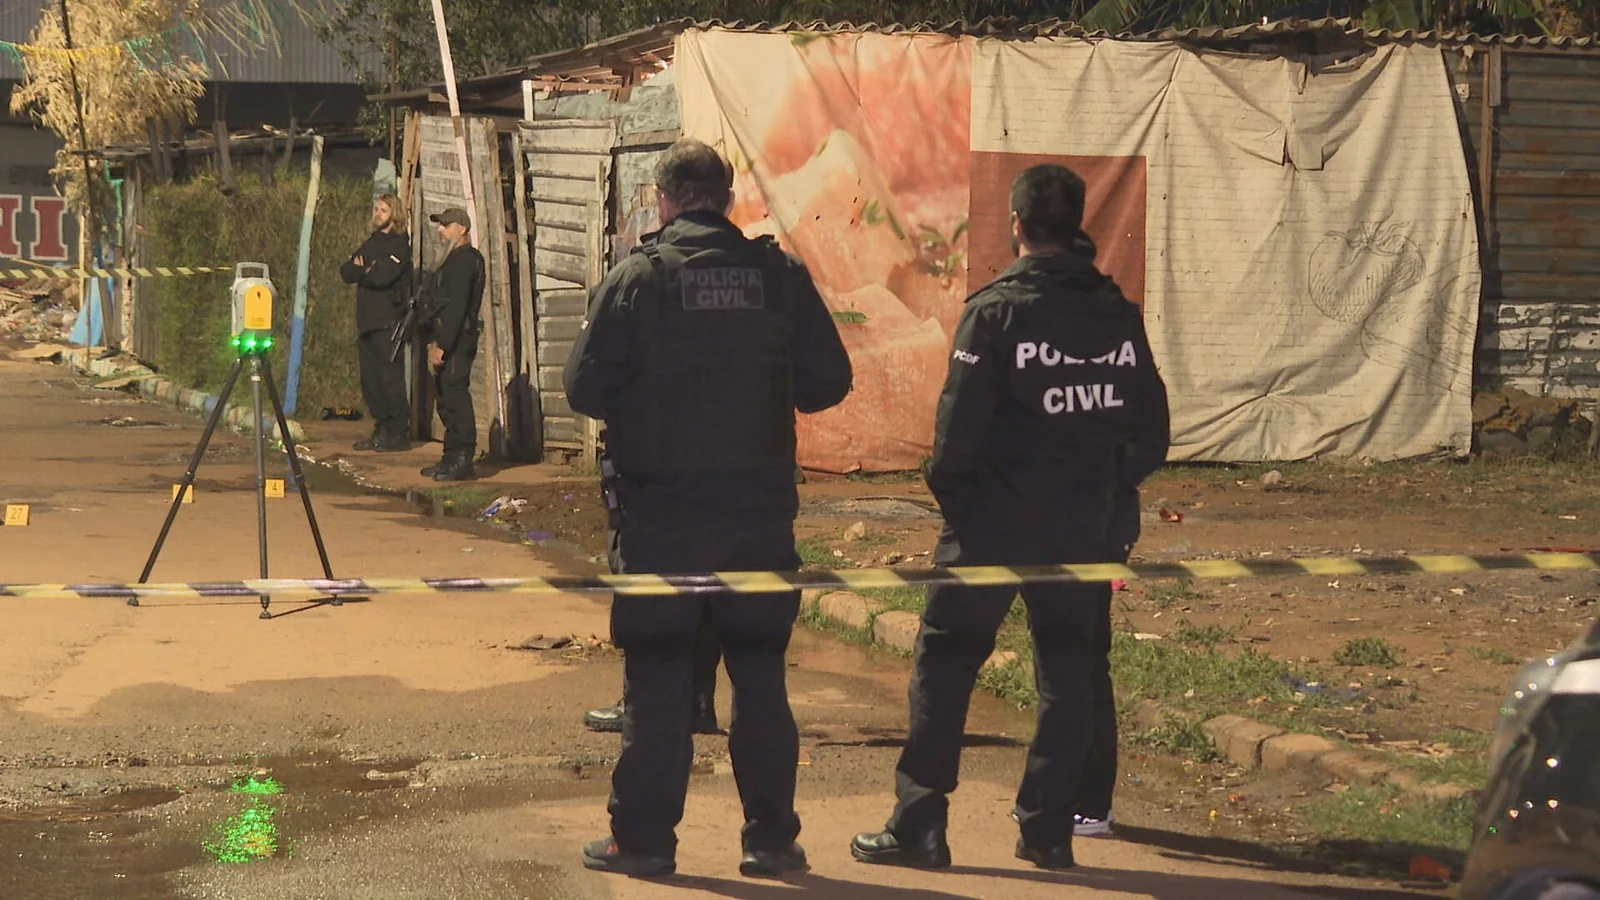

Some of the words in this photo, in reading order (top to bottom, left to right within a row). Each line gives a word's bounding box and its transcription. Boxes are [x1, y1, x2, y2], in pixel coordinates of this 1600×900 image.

[696, 288, 750, 307] CIVIL
[1043, 383, 1124, 414] CIVIL
[10, 507, 23, 520] 27
